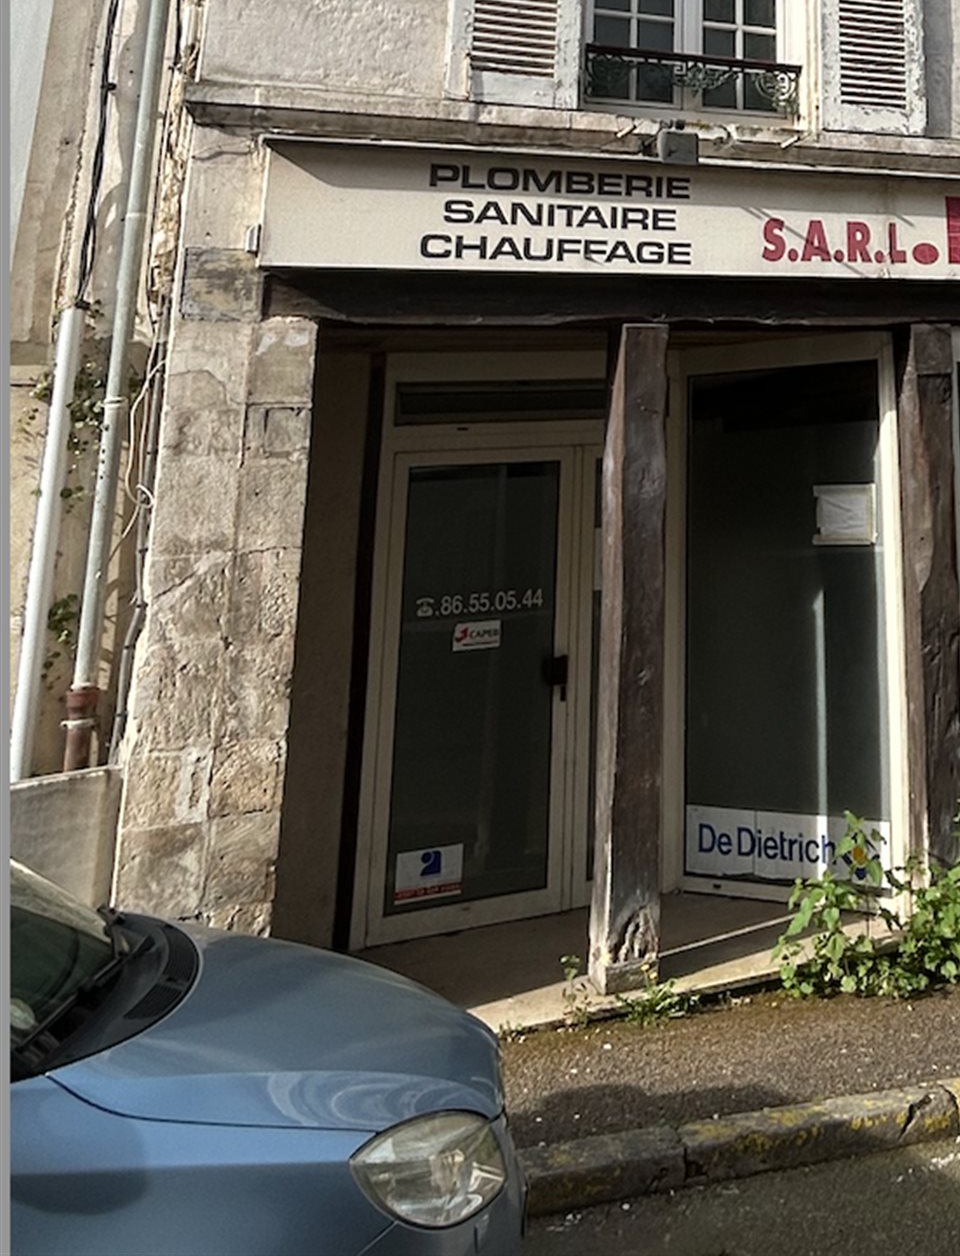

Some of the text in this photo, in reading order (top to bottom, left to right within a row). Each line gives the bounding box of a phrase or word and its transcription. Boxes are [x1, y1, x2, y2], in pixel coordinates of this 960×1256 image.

[429, 163, 691, 199] PLOMBERIE
[444, 200, 677, 231] SANITAIRE
[420, 234, 692, 265] CHAUFFAGE
[698, 823, 836, 863] De Dietrich
